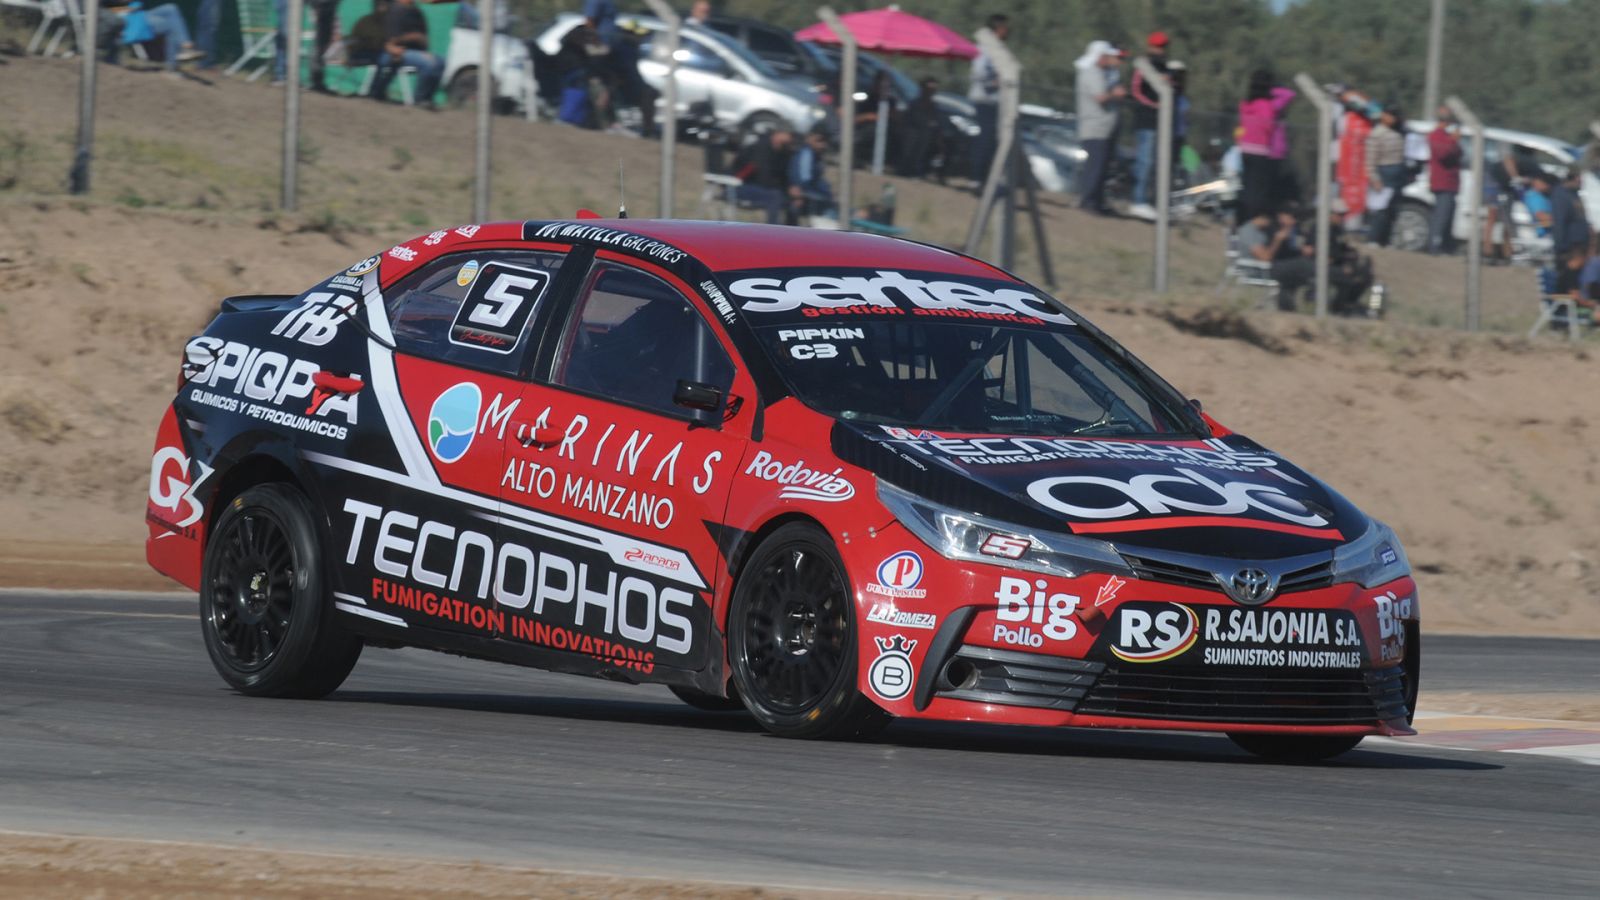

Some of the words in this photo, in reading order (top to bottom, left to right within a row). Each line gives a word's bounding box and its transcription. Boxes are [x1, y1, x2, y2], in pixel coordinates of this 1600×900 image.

[560, 224, 624, 245] MATILLA
[621, 235, 688, 264] GALPONES
[468, 273, 539, 328] 5
[729, 271, 1077, 326] sertec
[802, 304, 905, 318] gestión
[912, 307, 1046, 326] ambiental
[778, 327, 865, 342] PIPKIN
[789, 343, 839, 360] C3
[190, 388, 239, 414] QUIMICOS
[238, 401, 249, 414] Y
[246, 404, 349, 441] PETROQUIMICOS
[886, 437, 1277, 467] TECNOPHOS
[959, 451, 1098, 465] FUMIGATION
[1104, 452, 1255, 472] INNOVATIONS
[744, 450, 851, 495] Rodovía
[501, 457, 556, 499] ALTO
[561, 473, 675, 530] MANZANO
[982, 534, 1031, 559] 5
[343, 498, 694, 655] TECNOPHOS
[371, 578, 505, 632] FUMIGATION
[511, 614, 655, 675] INNOVATIONS
[994, 575, 1081, 641] Big
[1204, 608, 1330, 646] R.SAJONIA
[1335, 624, 1361, 646] S.A.
[993, 625, 1043, 648] Pollo
[1119, 608, 1183, 649] RS
[881, 666, 904, 687] B
[1203, 647, 1285, 667] SUMINISTROS
[1287, 649, 1361, 669] INDUSTRIALES
